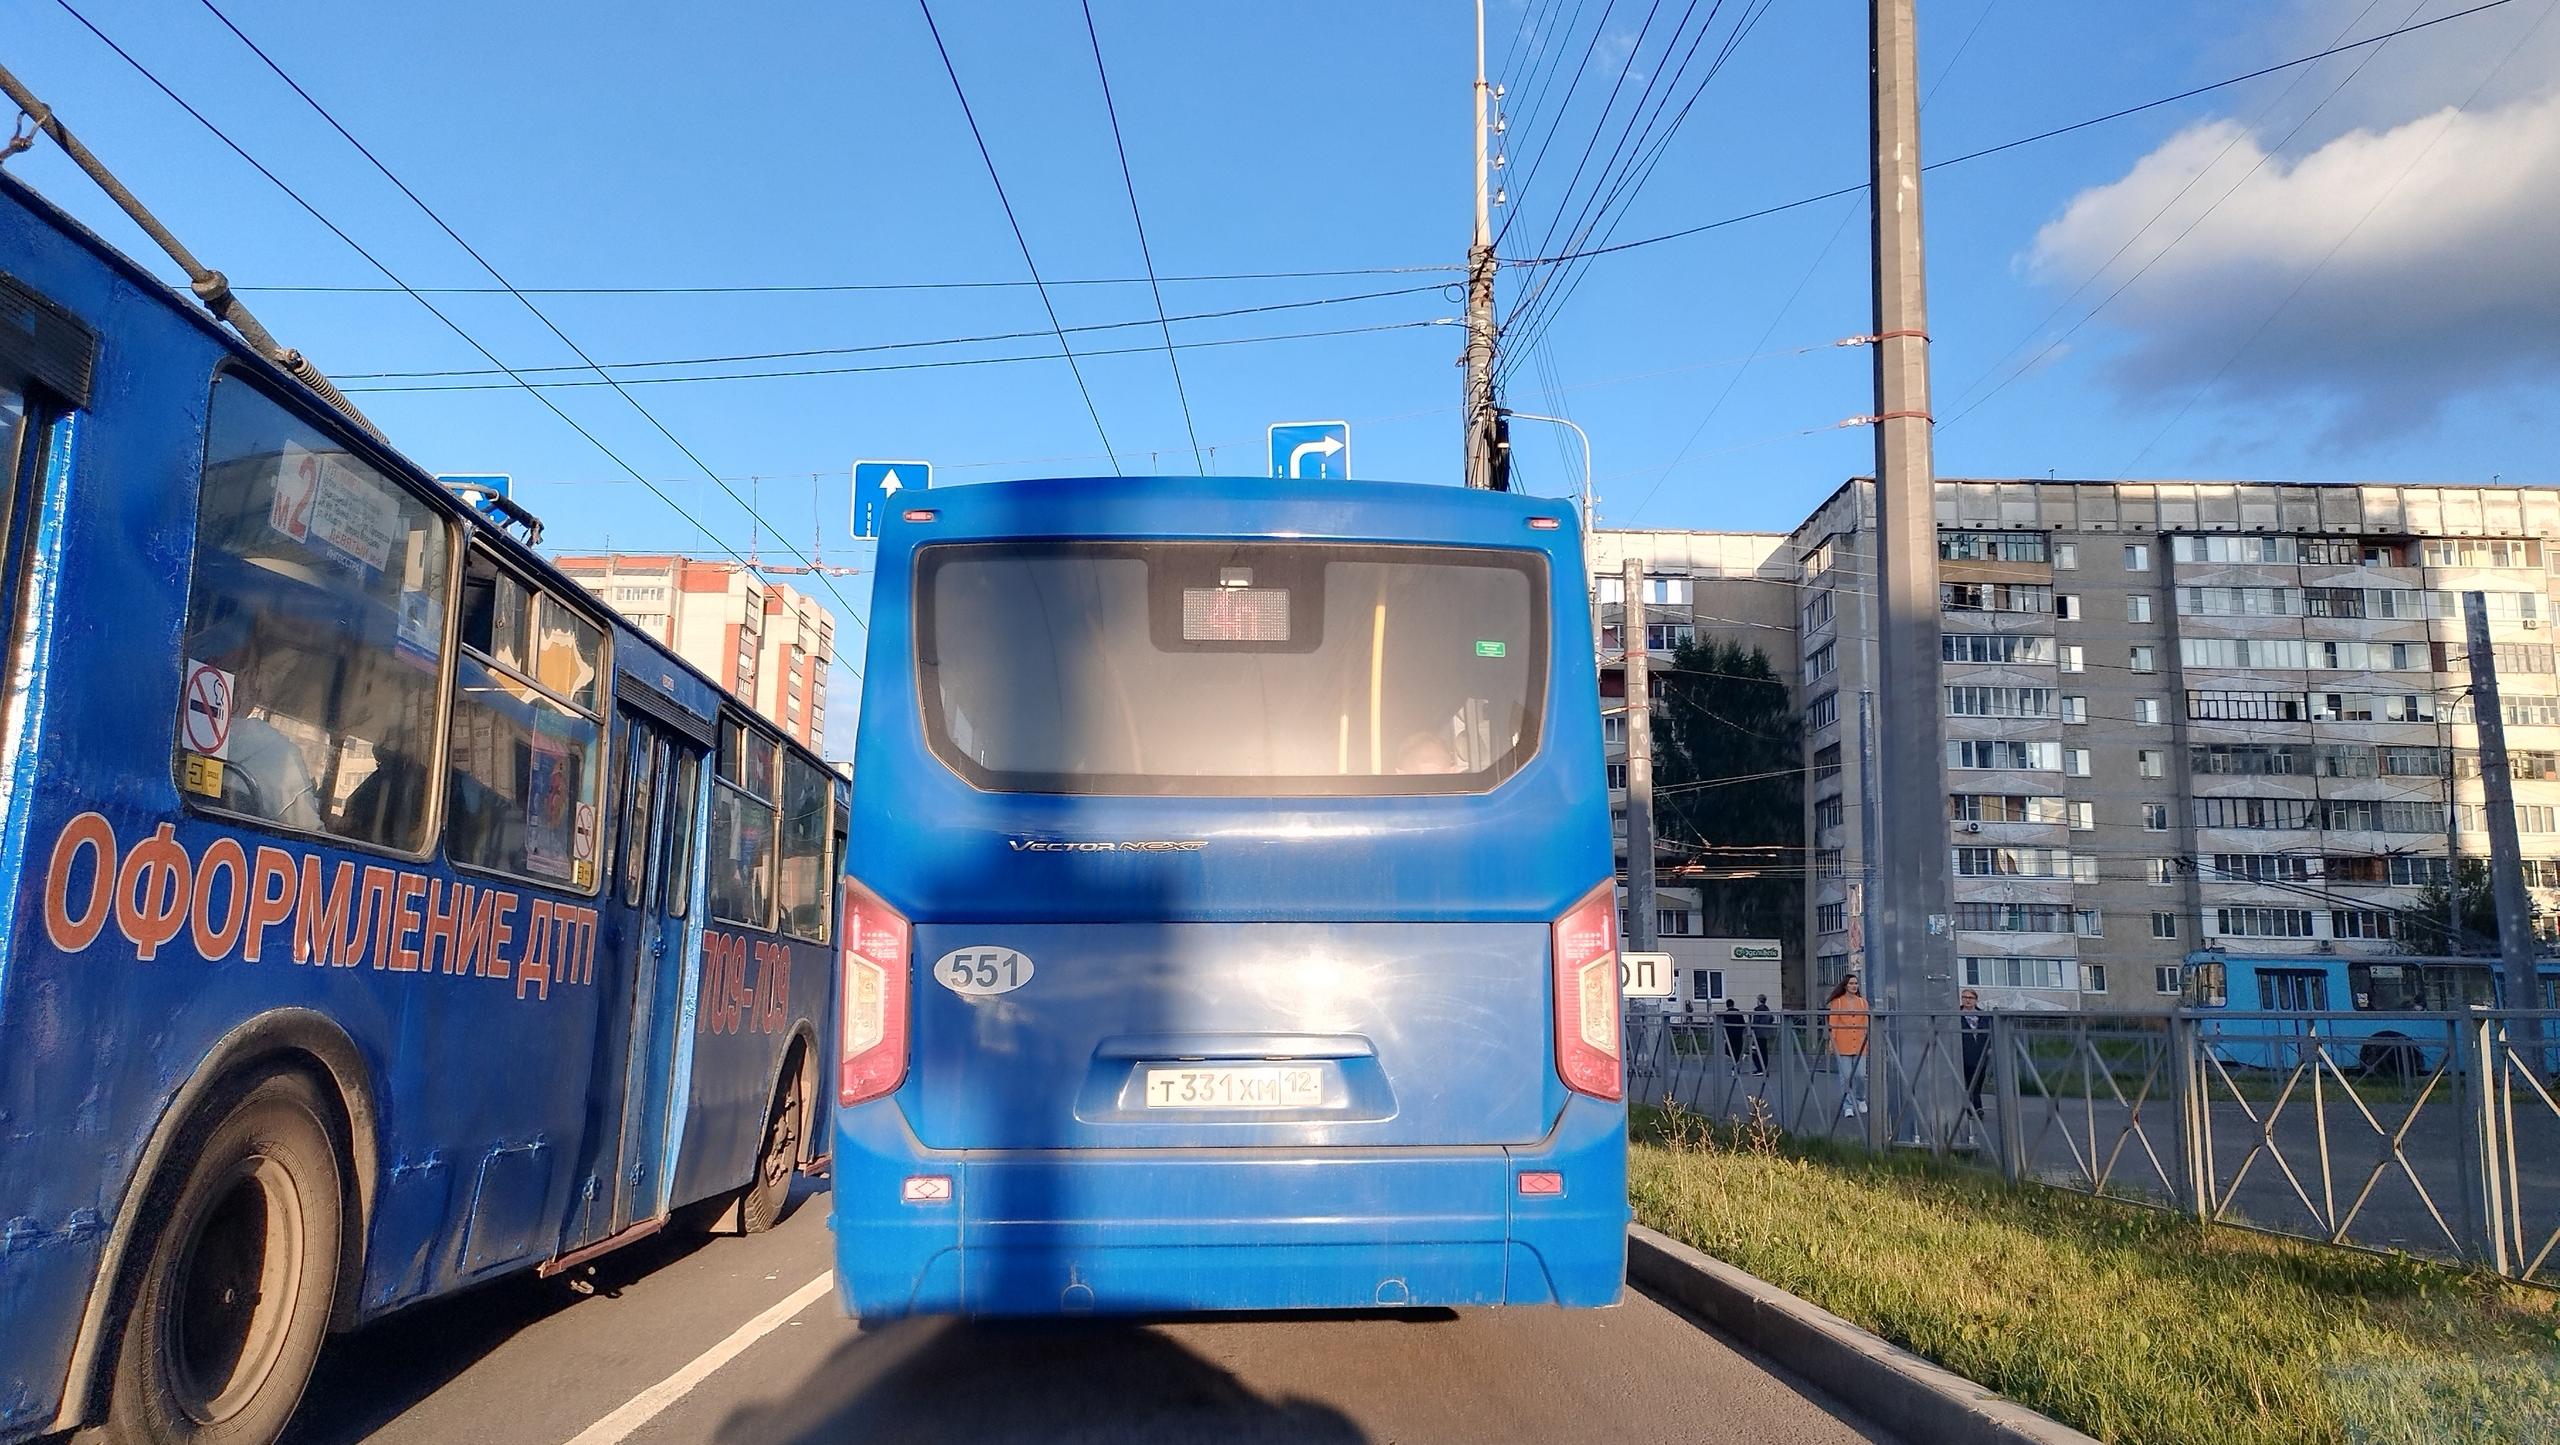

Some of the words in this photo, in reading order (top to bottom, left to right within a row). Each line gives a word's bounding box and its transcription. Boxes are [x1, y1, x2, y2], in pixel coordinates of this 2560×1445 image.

[1119, 841, 1209, 852] NEXT
[45, 811, 518, 978] ОФОРМЛЕНИЕ
[517, 899, 598, 1000] ДТП
[698, 930, 791, 1035] 709-709
[951, 953, 1018, 987] 551
